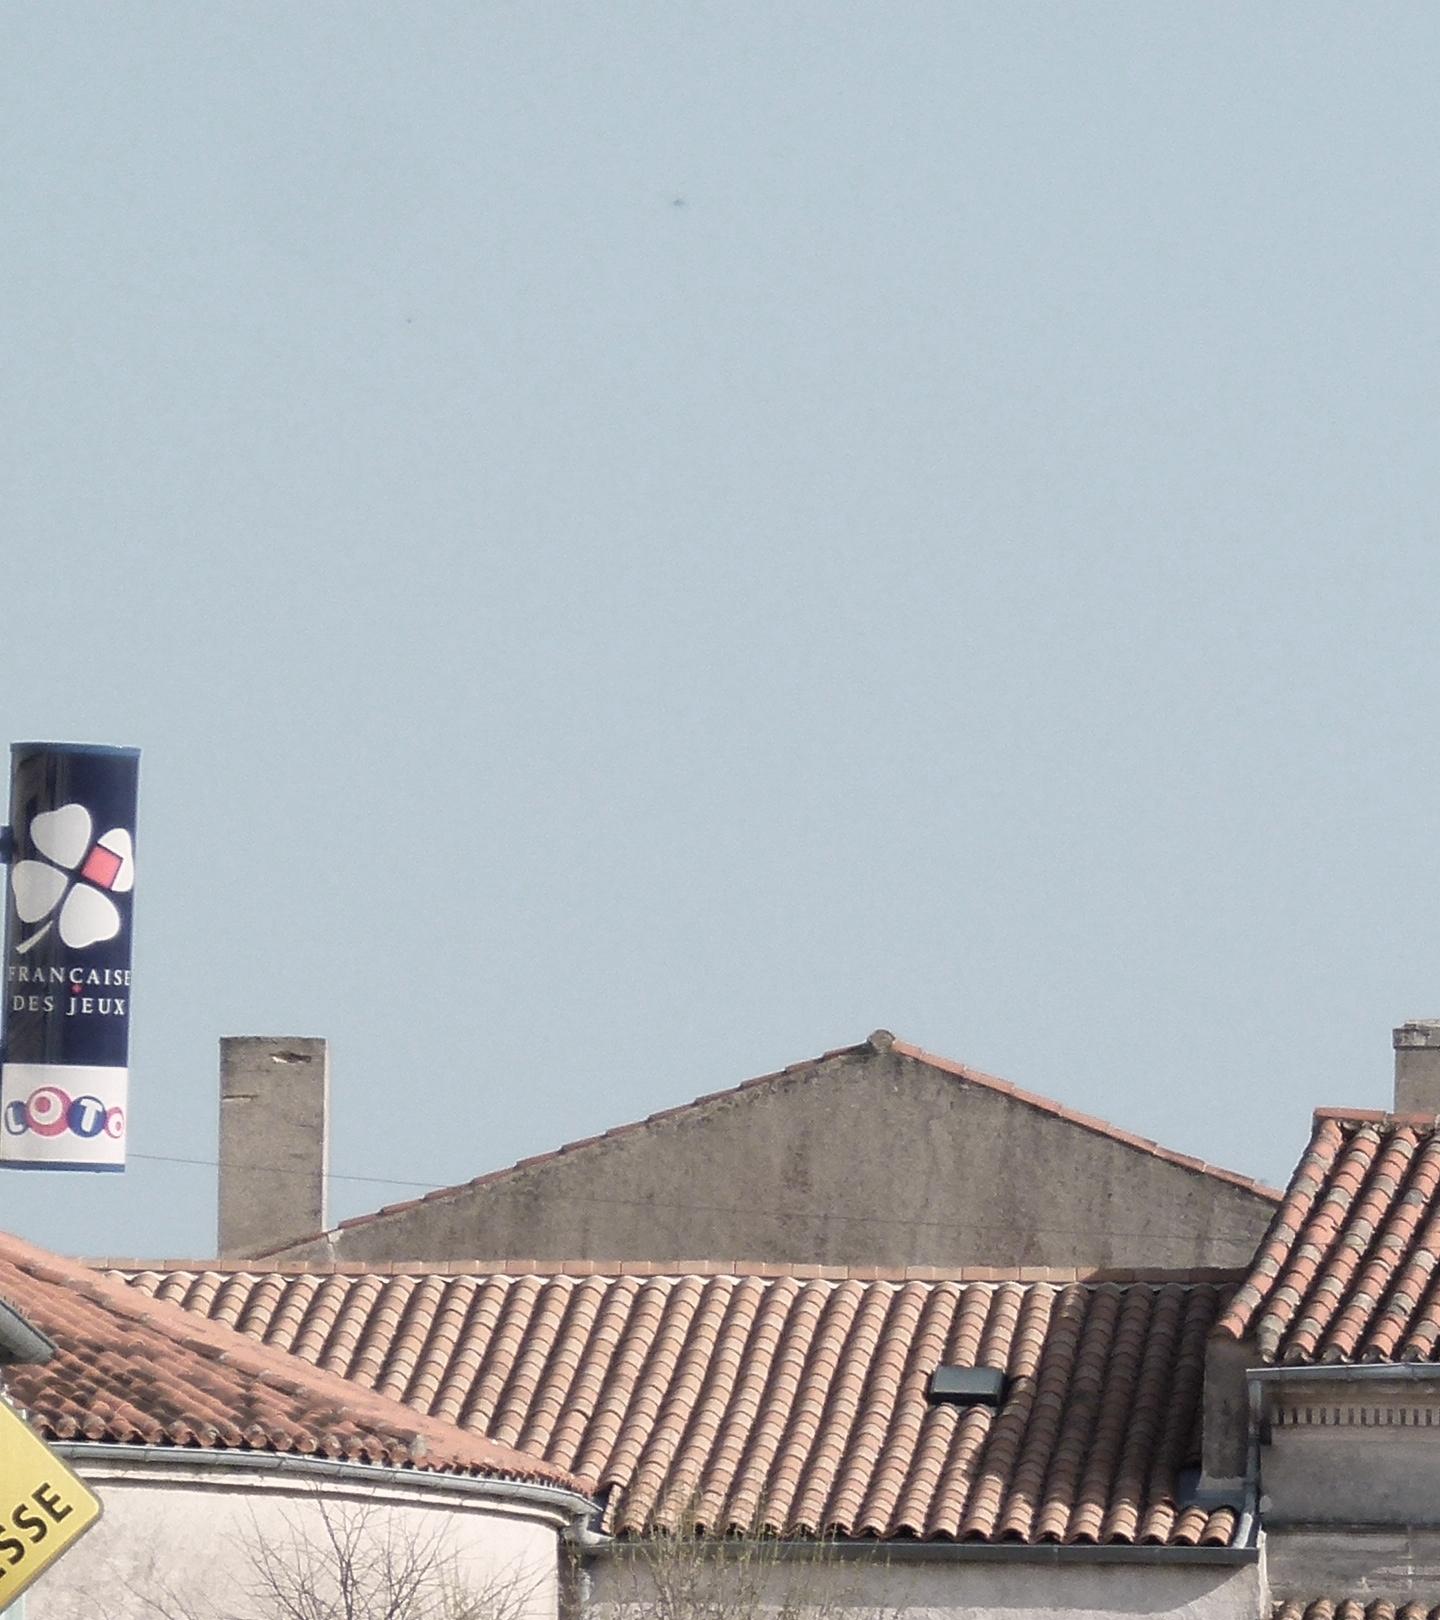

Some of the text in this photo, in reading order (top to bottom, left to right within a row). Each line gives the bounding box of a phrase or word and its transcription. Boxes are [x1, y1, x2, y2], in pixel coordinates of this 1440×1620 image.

[13, 996, 125, 1015] DES JEUX
[4, 1085, 125, 1140] LOTO
[0, 1482, 74, 1578] SSE
